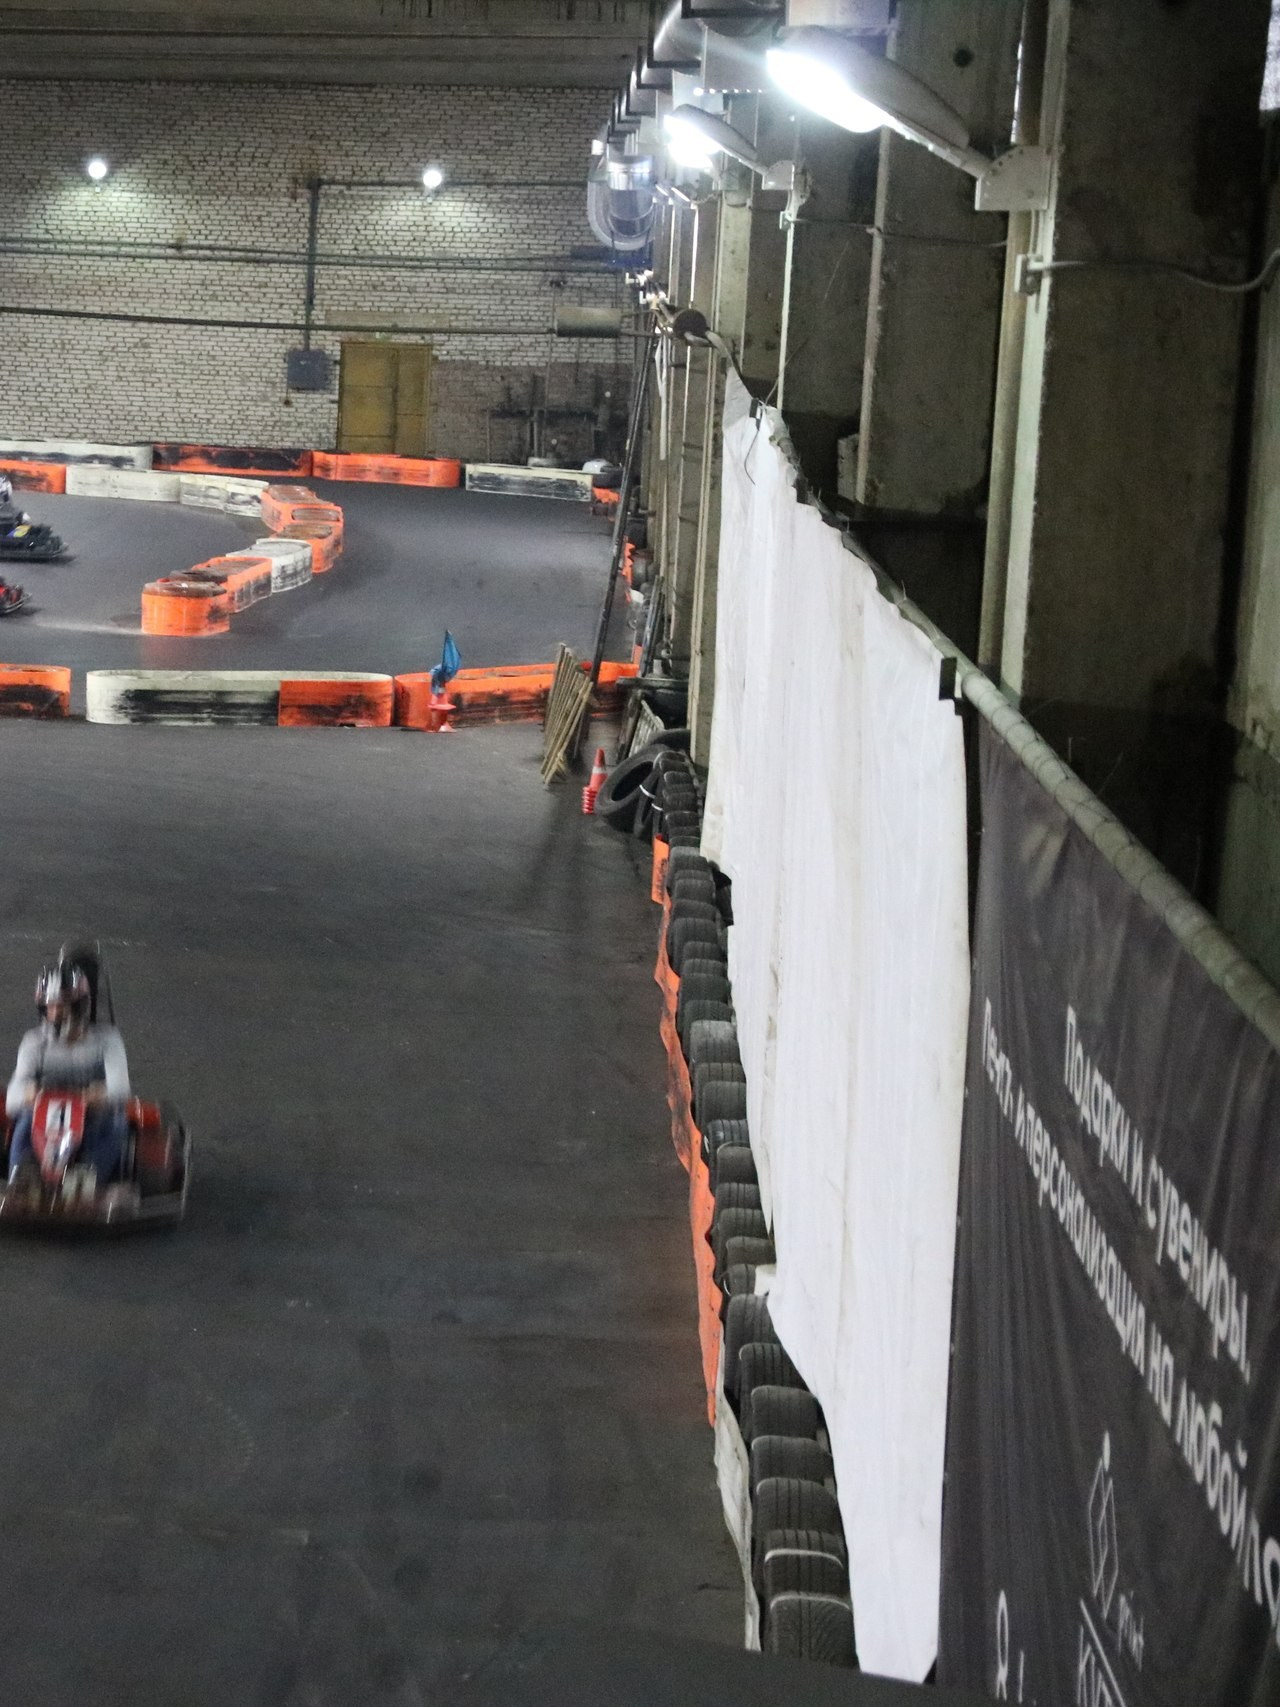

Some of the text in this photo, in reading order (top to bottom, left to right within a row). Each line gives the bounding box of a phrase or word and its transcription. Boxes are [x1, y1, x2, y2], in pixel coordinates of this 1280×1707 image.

[1063, 1004, 1131, 1183] Подарки
[1131, 1128, 1143, 1206] и
[1026, 1102, 1146, 1376] персонализация
[1148, 1321, 1174, 1426] на
[1176, 1378, 1248, 1564] любой
